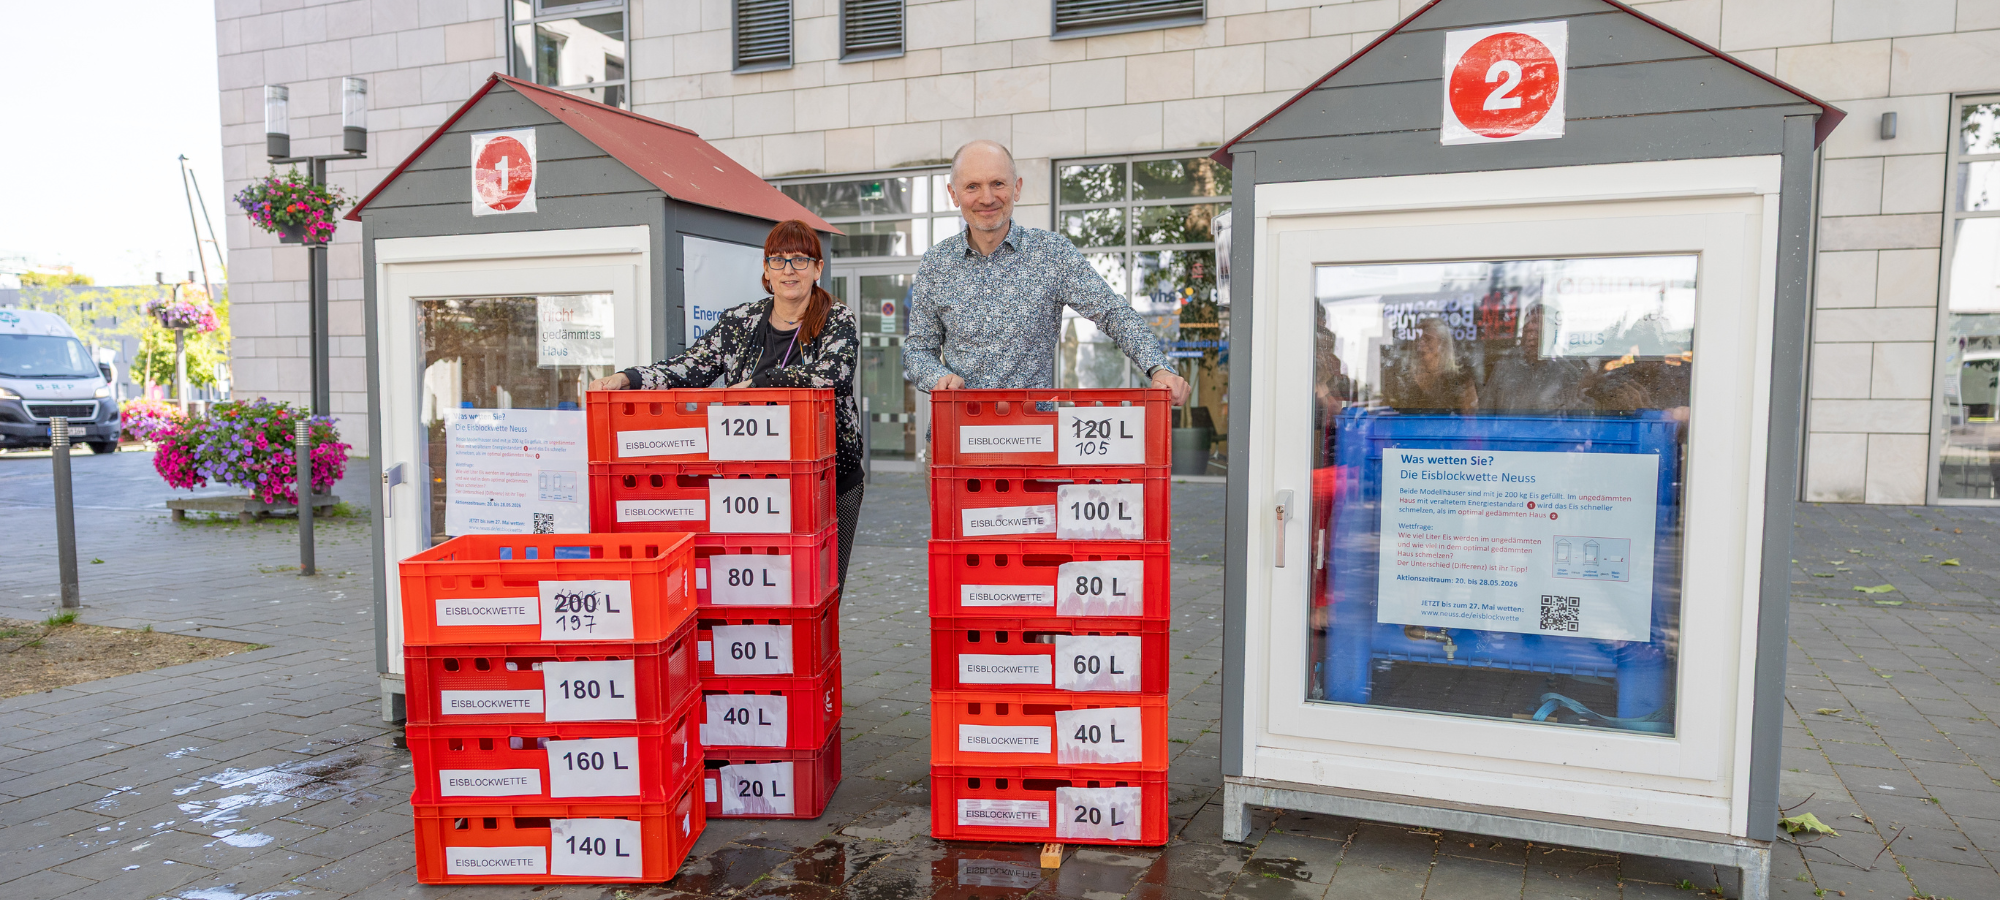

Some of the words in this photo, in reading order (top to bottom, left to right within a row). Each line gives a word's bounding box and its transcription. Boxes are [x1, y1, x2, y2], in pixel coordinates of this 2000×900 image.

[1482, 59, 1522, 111] 2
[495, 156, 509, 190] 1
[1150, 289, 1176, 302] vhs
[543, 307, 574, 321] nicht
[542, 329, 601, 342] gedämmtes
[542, 346, 568, 356] Haus
[722, 418, 758, 436] 120
[766, 418, 778, 436] L
[1120, 420, 1134, 438] L
[625, 438, 696, 451] EISBLOCKWETTE
[968, 435, 1042, 447] EISBLOCKWETTE
[1076, 442, 1108, 454] 105
[1401, 454, 1424, 464] Was
[1428, 455, 1467, 465] wetten
[1470, 456, 1494, 466] Sie?
[1400, 470, 1418, 479] Die
[1422, 470, 1498, 482] Eisblockwette
[1502, 473, 1536, 483] Neuss
[722, 496, 758, 514] 100
[768, 498, 780, 514] L
[1072, 502, 1110, 520] 100
[1118, 502, 1132, 520] L
[624, 506, 695, 518] EISBLOCKWETTE
[970, 515, 1044, 529] EISBLOCKWETTE
[1398, 523, 1434, 531] Wettfrage:
[1491, 546, 1532, 554] gedämmten
[1452, 562, 1487, 571] (Differenz)
[728, 568, 754, 586] 80
[762, 568, 776, 586] L
[1396, 575, 1454, 584] Aktionszeitraum:
[1479, 579, 1518, 587] 28.05.2026
[1076, 576, 1102, 596] 80
[1112, 578, 1126, 596] L
[606, 594, 620, 612] L
[968, 592, 1042, 603] EISBLOCKWETTE
[445, 606, 525, 616] EISBLOCKWETTE
[1421, 611, 1519, 621] www.neuss.de/eisblockwette
[556, 614, 594, 630] 197
[730, 642, 756, 660] 60
[764, 642, 778, 660] L
[967, 664, 1040, 674] EISBLOCKWETTE
[1074, 654, 1100, 674] 60
[1110, 656, 1124, 674] L
[560, 680, 600, 698] 180
[610, 680, 624, 698] L
[451, 699, 530, 709] EISBLOCKWETTE
[724, 708, 750, 726] 40
[758, 708, 772, 726] L
[967, 735, 1040, 746] EISBLOCKWETTE
[1074, 724, 1100, 744] 40
[1110, 724, 1124, 742] L
[564, 752, 604, 770] 160
[614, 752, 628, 770] L
[449, 776, 528, 788] EISBLOCKWETTE
[738, 780, 764, 798] 20
[772, 780, 786, 798] L
[965, 810, 1038, 821] EISBLOCKWETTE
[1074, 806, 1102, 824] 20
[1112, 808, 1124, 826] L
[566, 836, 606, 856] 140
[616, 838, 630, 856] L
[455, 858, 534, 868] EISBLOCKWETTE
